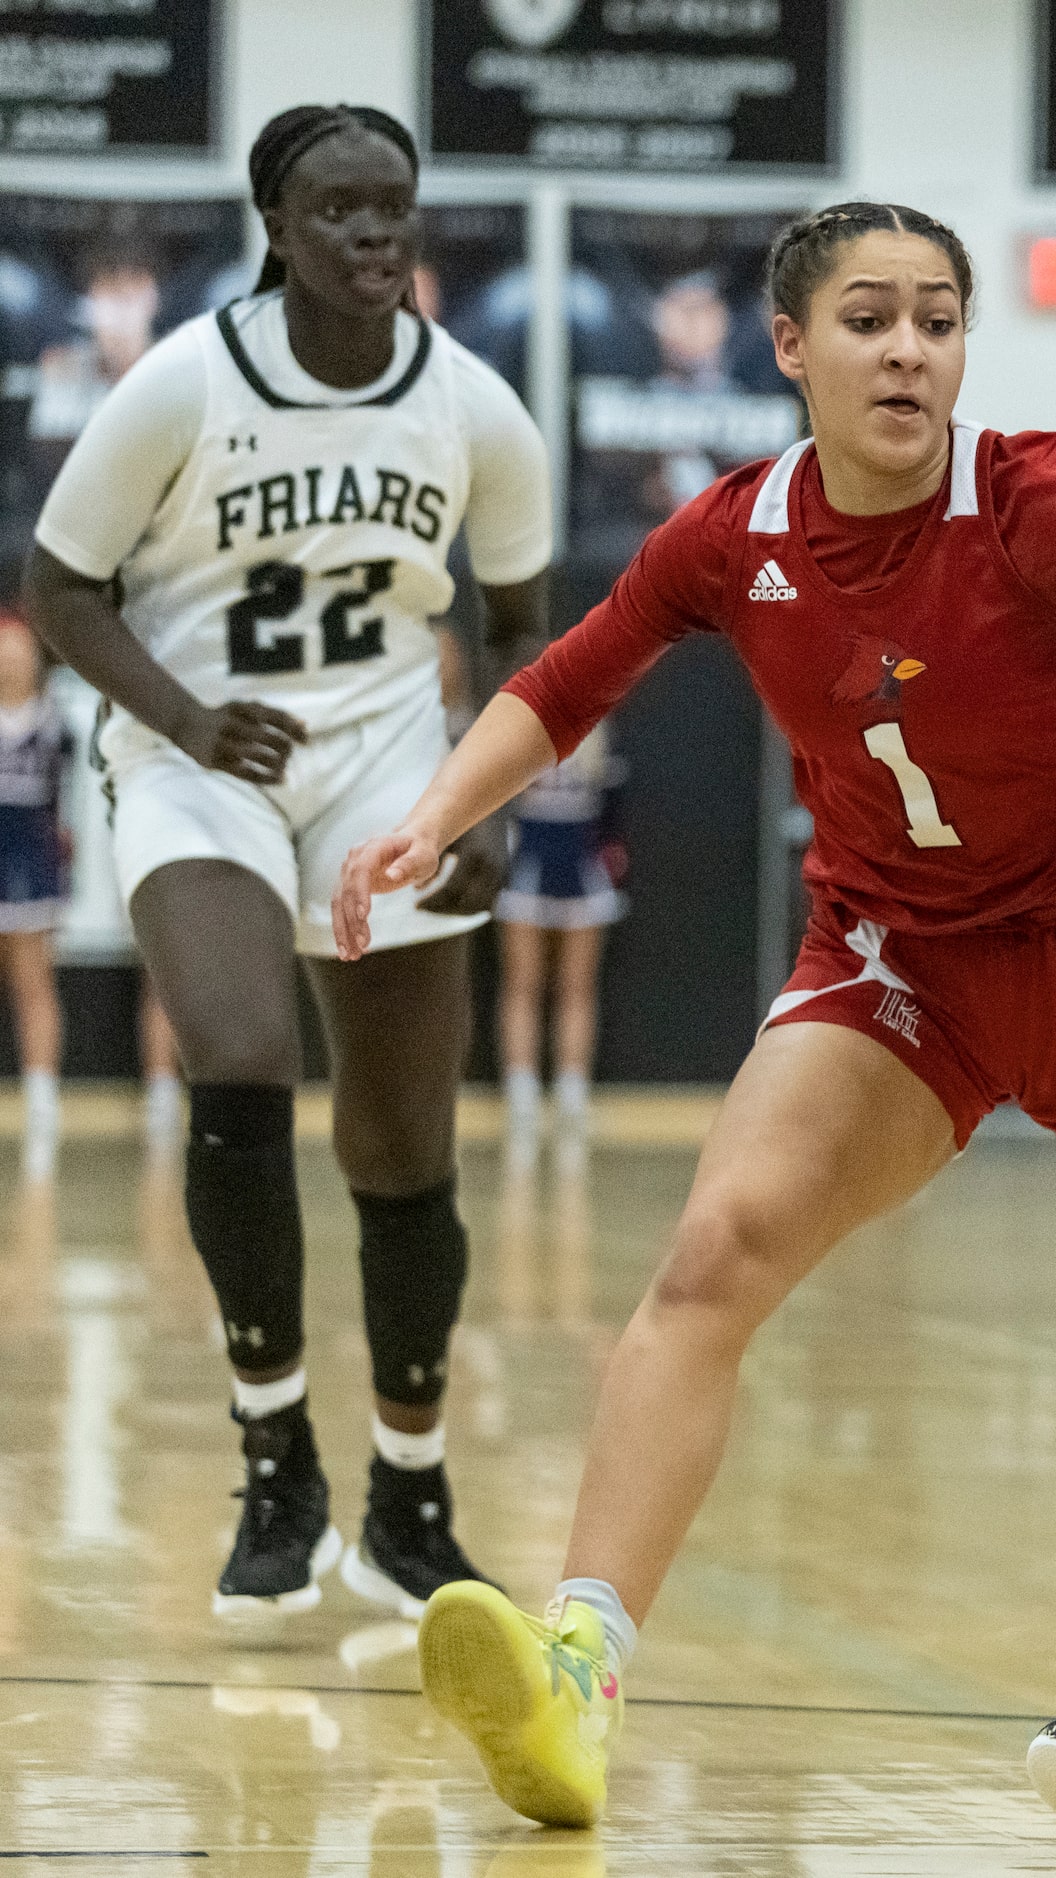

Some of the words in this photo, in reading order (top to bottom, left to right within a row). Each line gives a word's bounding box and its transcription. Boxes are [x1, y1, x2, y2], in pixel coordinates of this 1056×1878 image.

[216, 464, 446, 551] FRIARS
[226, 558, 397, 676] 22
[748, 585, 798, 602] adidas
[863, 721, 963, 850] 1
